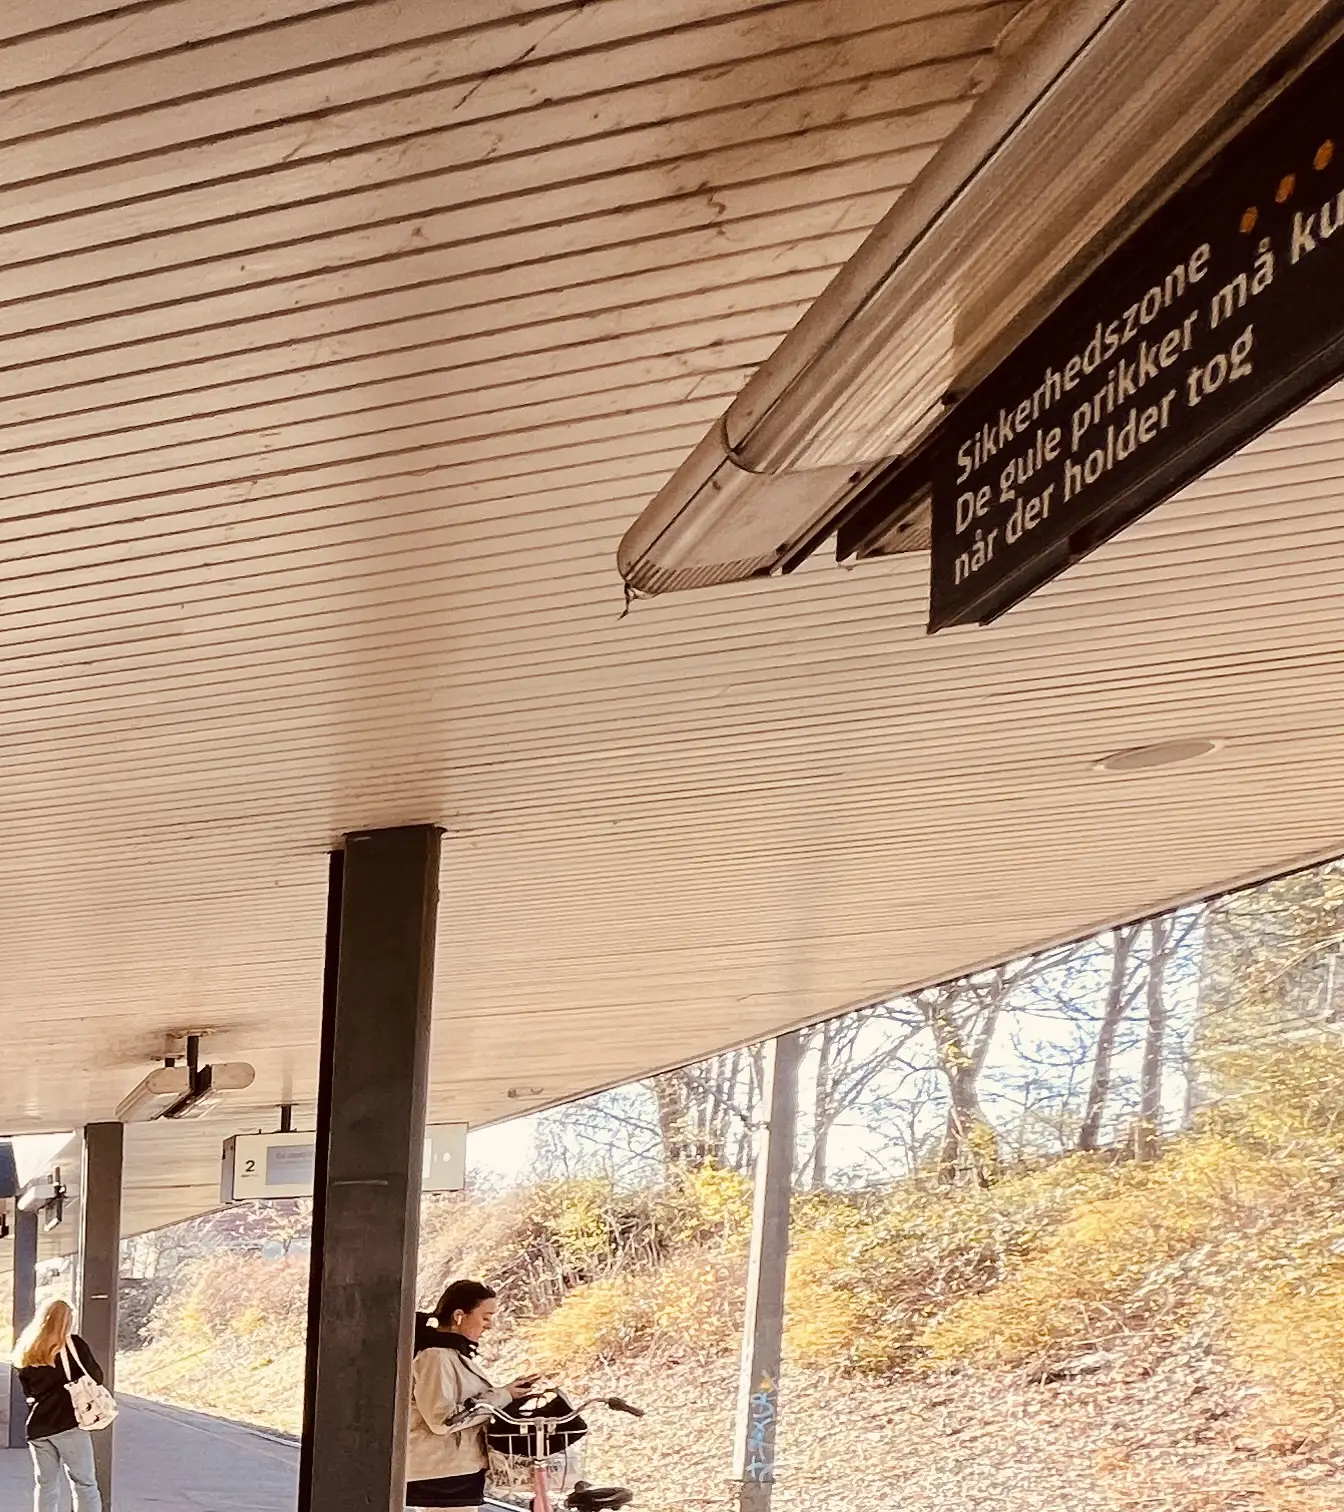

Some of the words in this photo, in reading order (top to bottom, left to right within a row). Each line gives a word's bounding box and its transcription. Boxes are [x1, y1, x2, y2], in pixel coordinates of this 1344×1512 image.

[955, 529, 998, 584] når
[1006, 483, 1054, 544] der
[1064, 389, 1176, 502] holder
[1188, 324, 1253, 406] tog
[956, 486, 991, 535] De
[1000, 428, 1061, 503] gule
[1072, 310, 1198, 452] prikker
[1211, 237, 1273, 329] må
[957, 243, 1209, 485] Sikkerhedszone
[245, 1159, 256, 1173] 2
